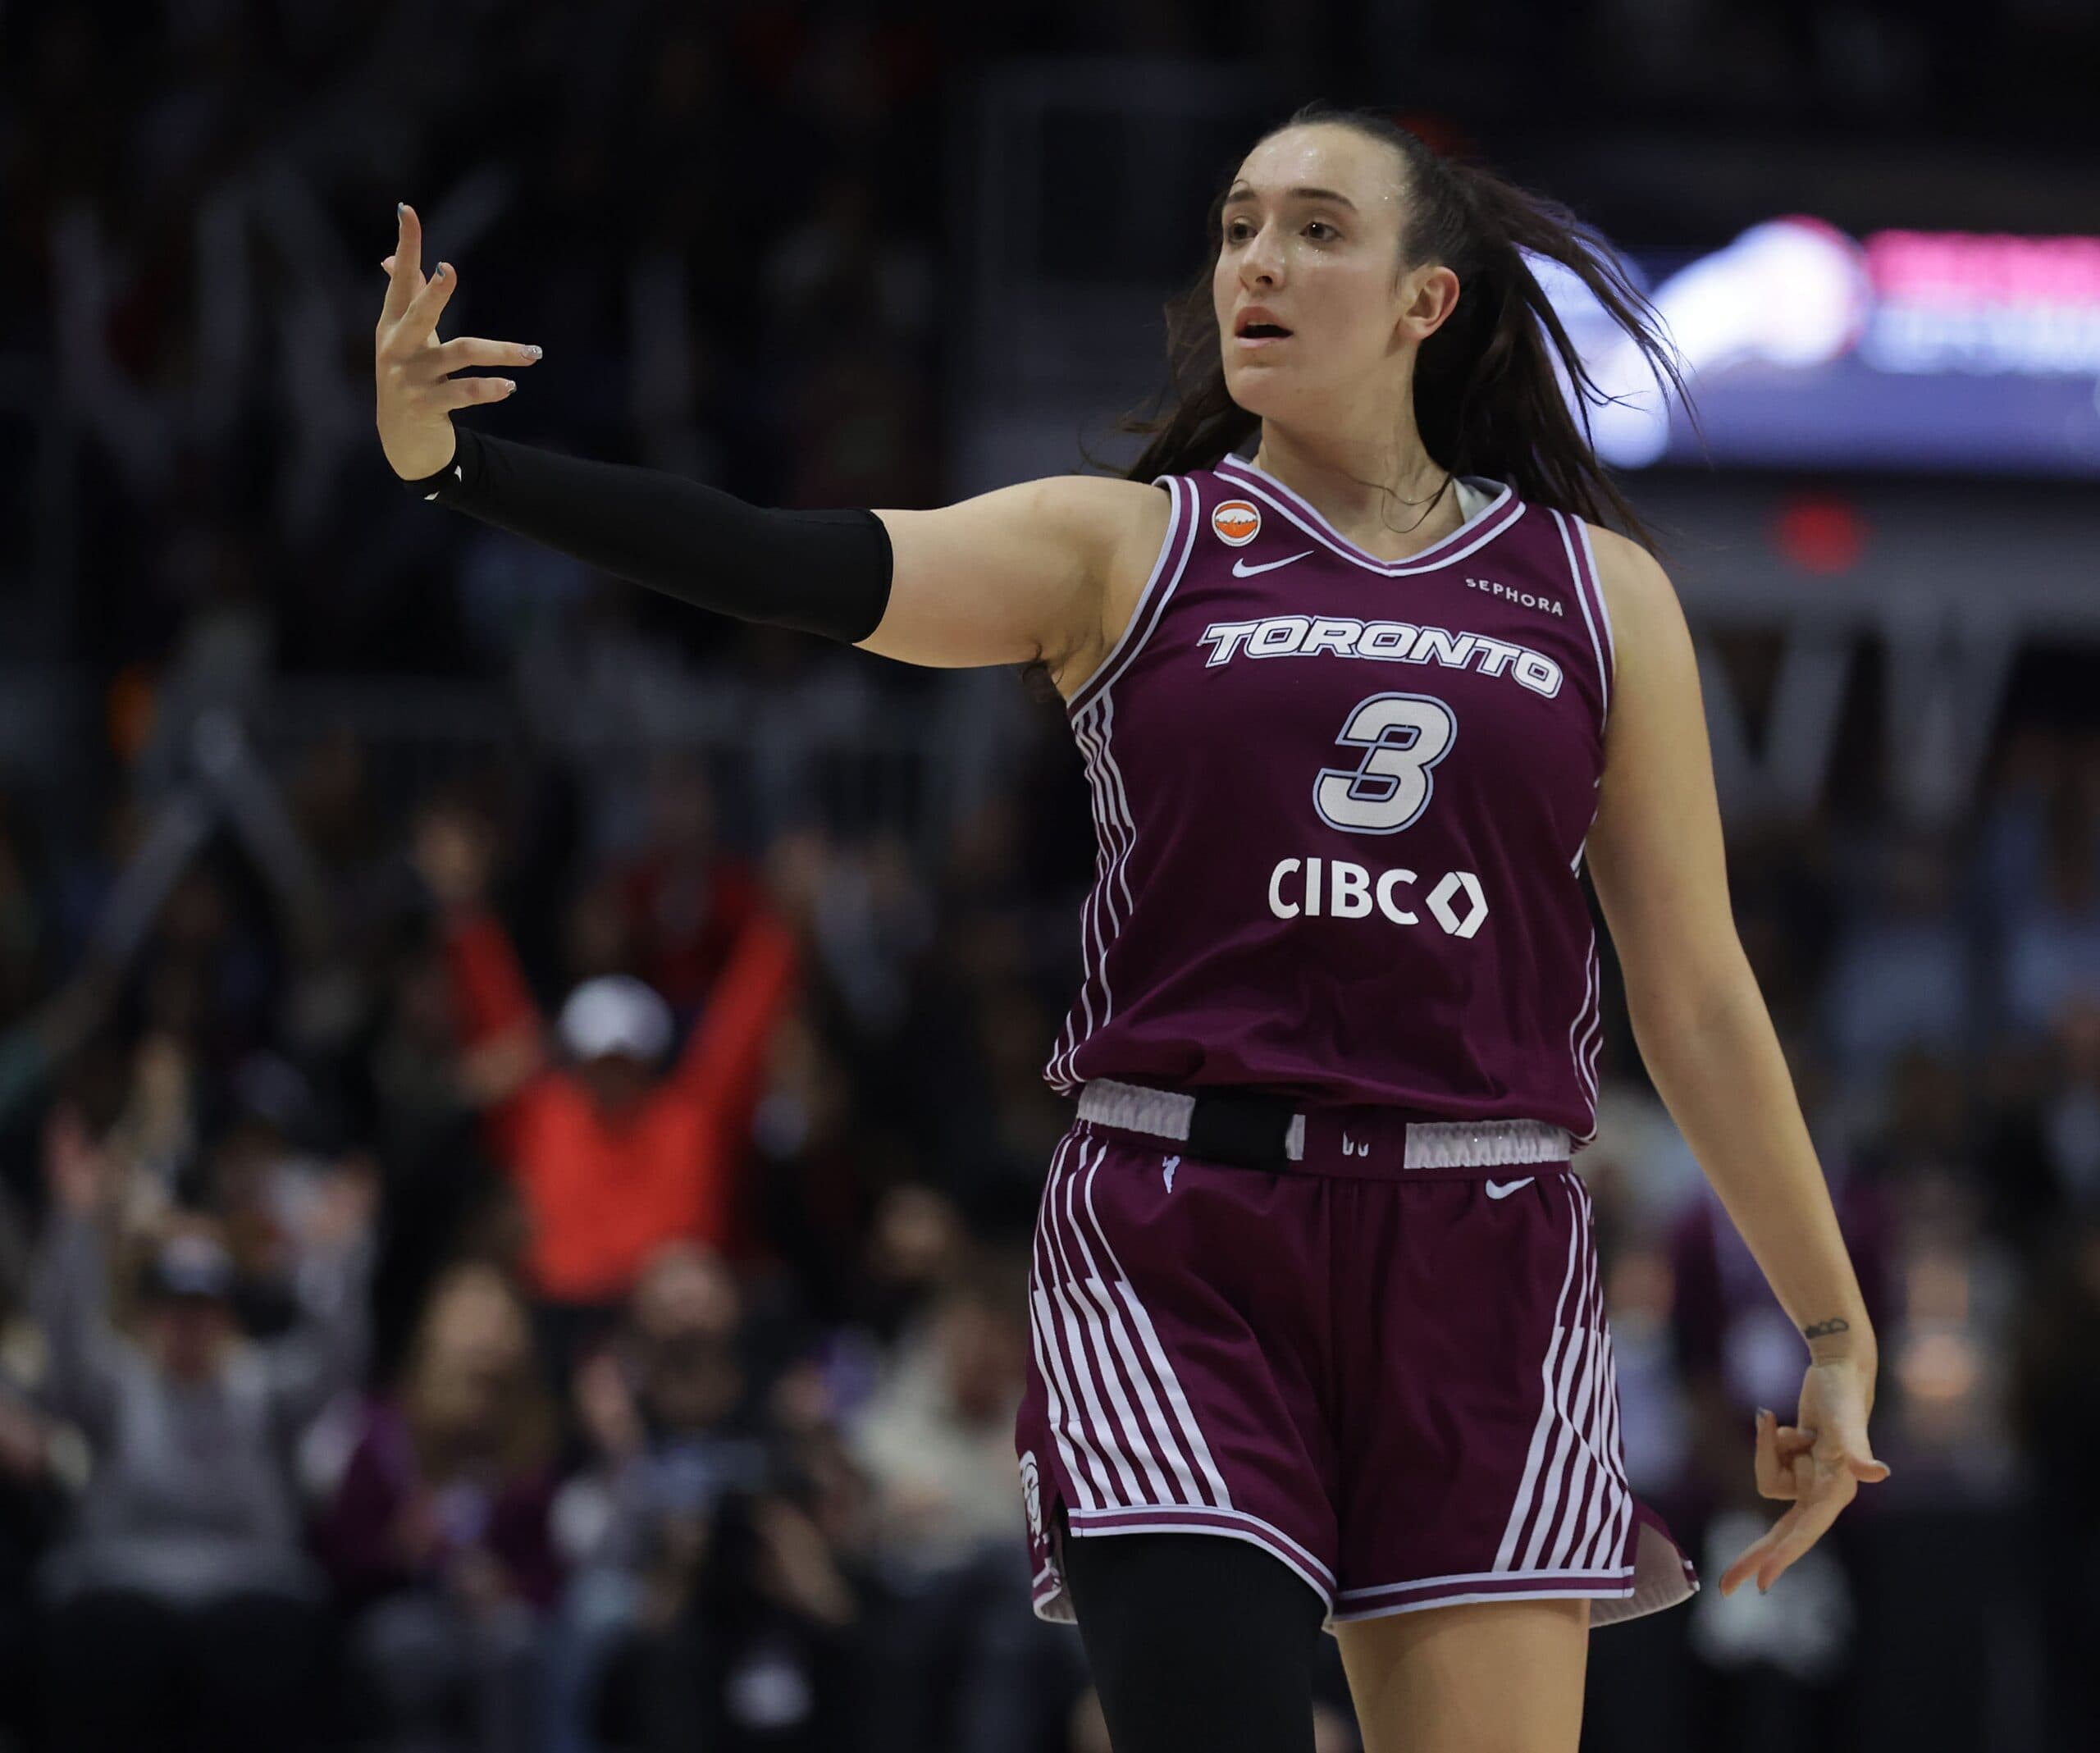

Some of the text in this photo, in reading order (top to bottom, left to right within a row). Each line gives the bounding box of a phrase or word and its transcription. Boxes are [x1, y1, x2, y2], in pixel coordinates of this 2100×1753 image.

[1465, 577, 1564, 617] SEPHORA
[1197, 614, 1564, 699] TORONTO
[1312, 692, 1458, 835] 3
[1268, 857, 1419, 925] CIBC
